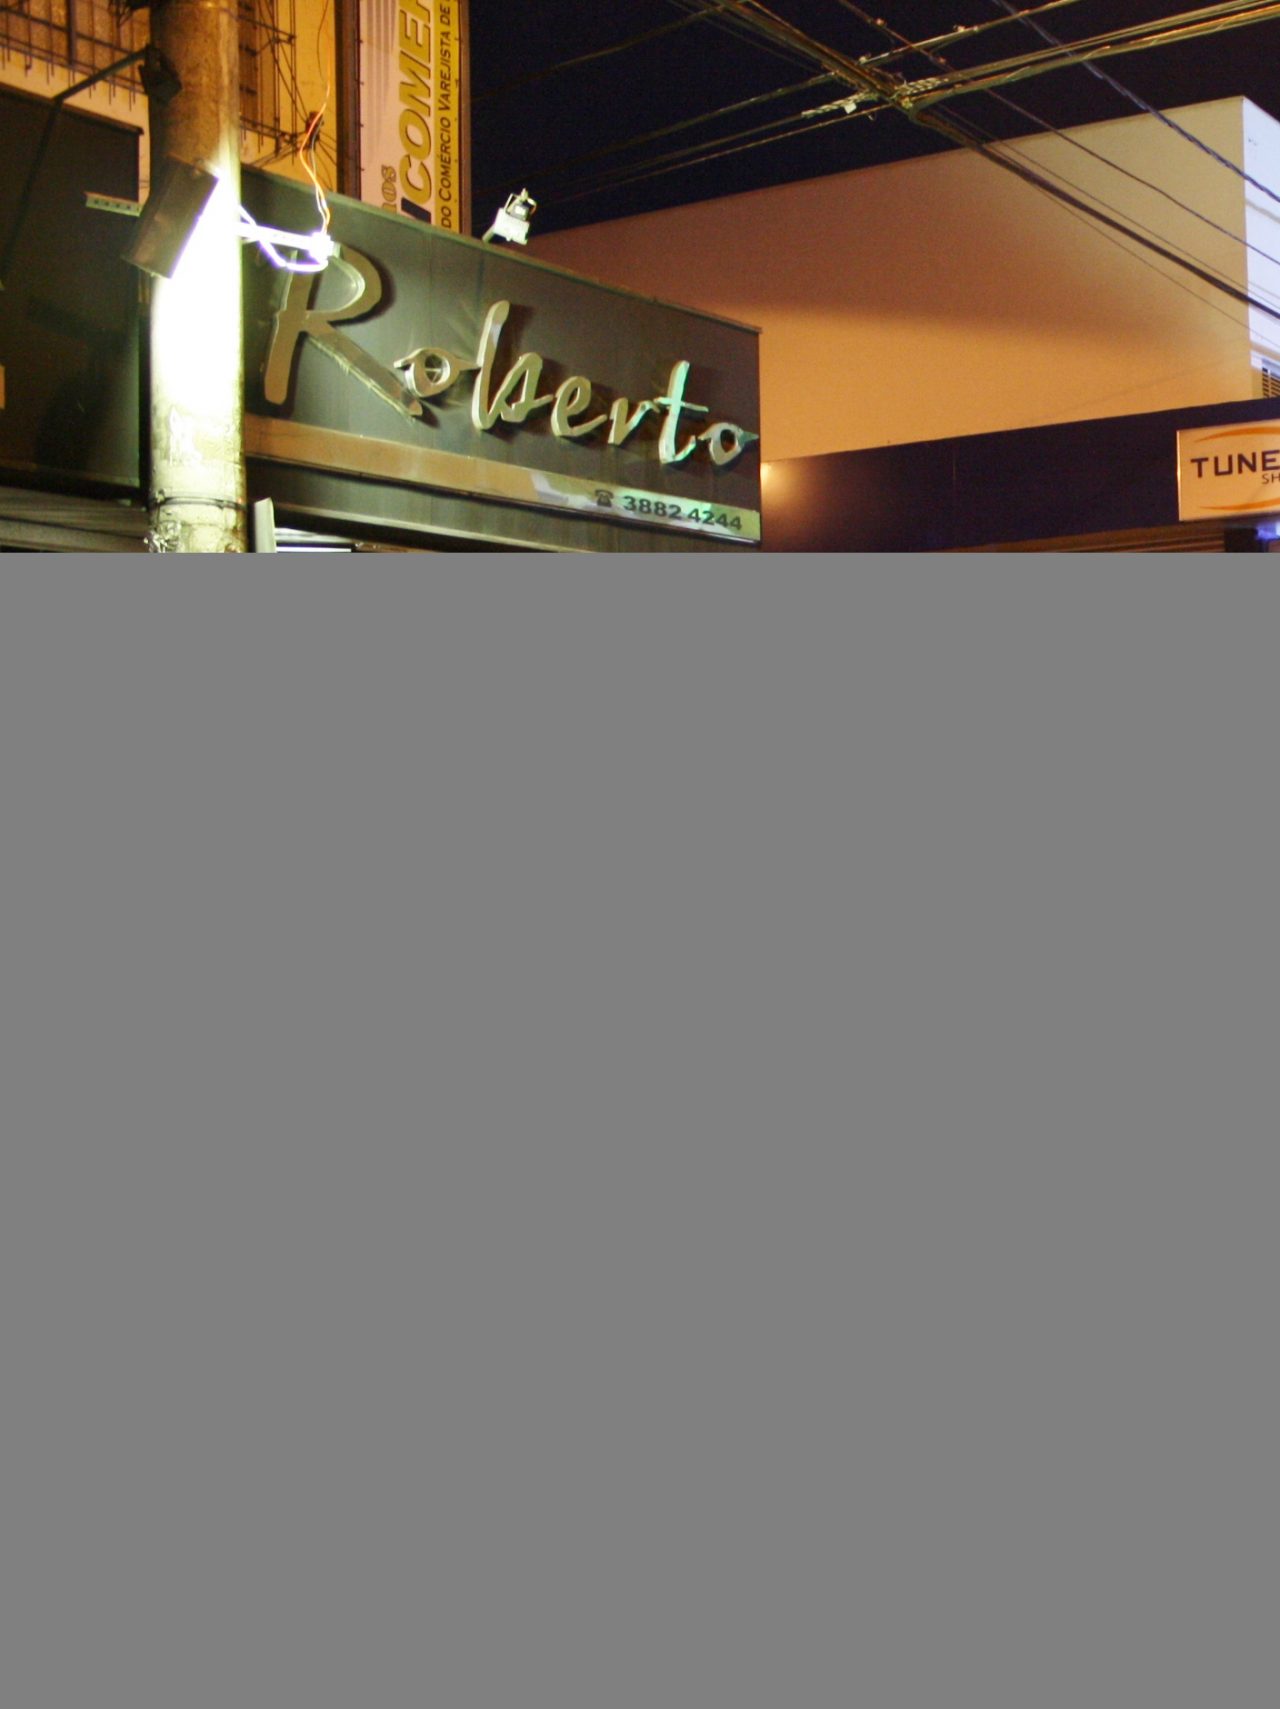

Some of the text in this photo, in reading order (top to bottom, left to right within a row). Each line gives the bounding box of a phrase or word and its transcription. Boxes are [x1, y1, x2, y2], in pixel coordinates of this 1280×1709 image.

[440, 3, 452, 27] DE
[438, 31, 452, 112] VAREJISTA
[437, 116, 453, 202] COMÉRCIO
[264, 243, 759, 465] Roberto
[623, 495, 742, 531] 3882 4244
